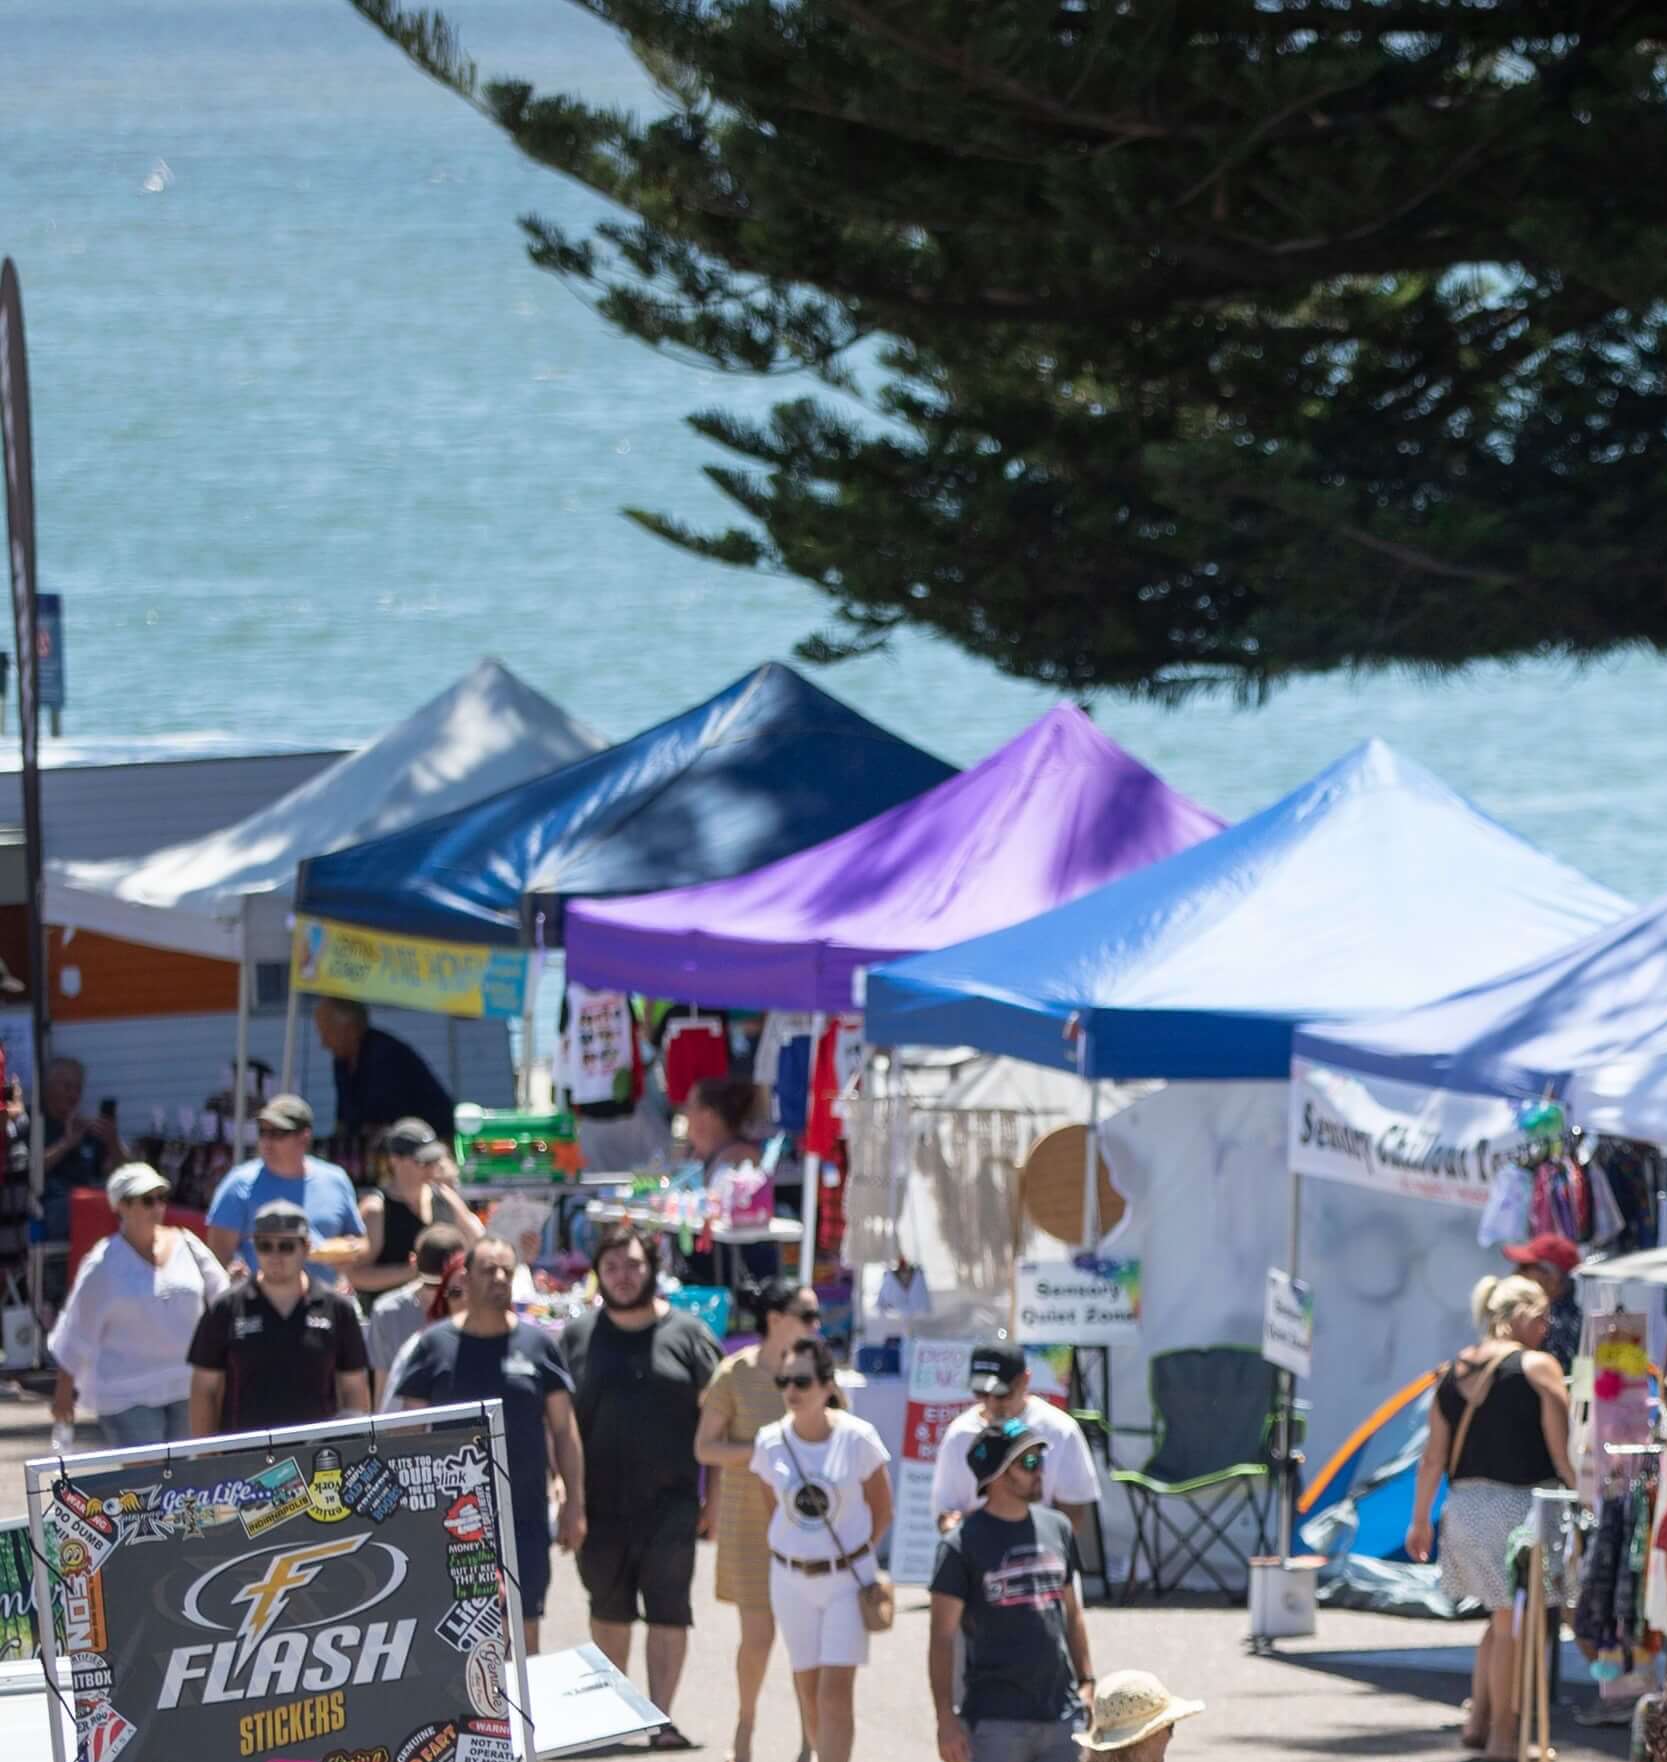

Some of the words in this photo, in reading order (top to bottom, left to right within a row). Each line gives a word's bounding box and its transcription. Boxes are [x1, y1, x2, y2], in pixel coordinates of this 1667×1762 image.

[1022, 1310, 1077, 1326] Quiet
[1084, 1309, 1138, 1323] Zone
[399, 1467, 432, 1487] OUD
[63, 1494, 108, 1529] WARNG
[409, 1494, 436, 1511] OLD
[71, 1520, 104, 1551] DUMB
[455, 1575, 475, 1585] THE
[480, 1571, 496, 1583] KID
[445, 1597, 488, 1637] Life
[157, 1618, 417, 1710] FLASH
[74, 1670, 112, 1690] ITBOX
[240, 1690, 345, 1757] STICKERS
[475, 1723, 511, 1734] WARN
[470, 1738, 491, 1747] NOT
[496, 1742, 509, 1751] TO
